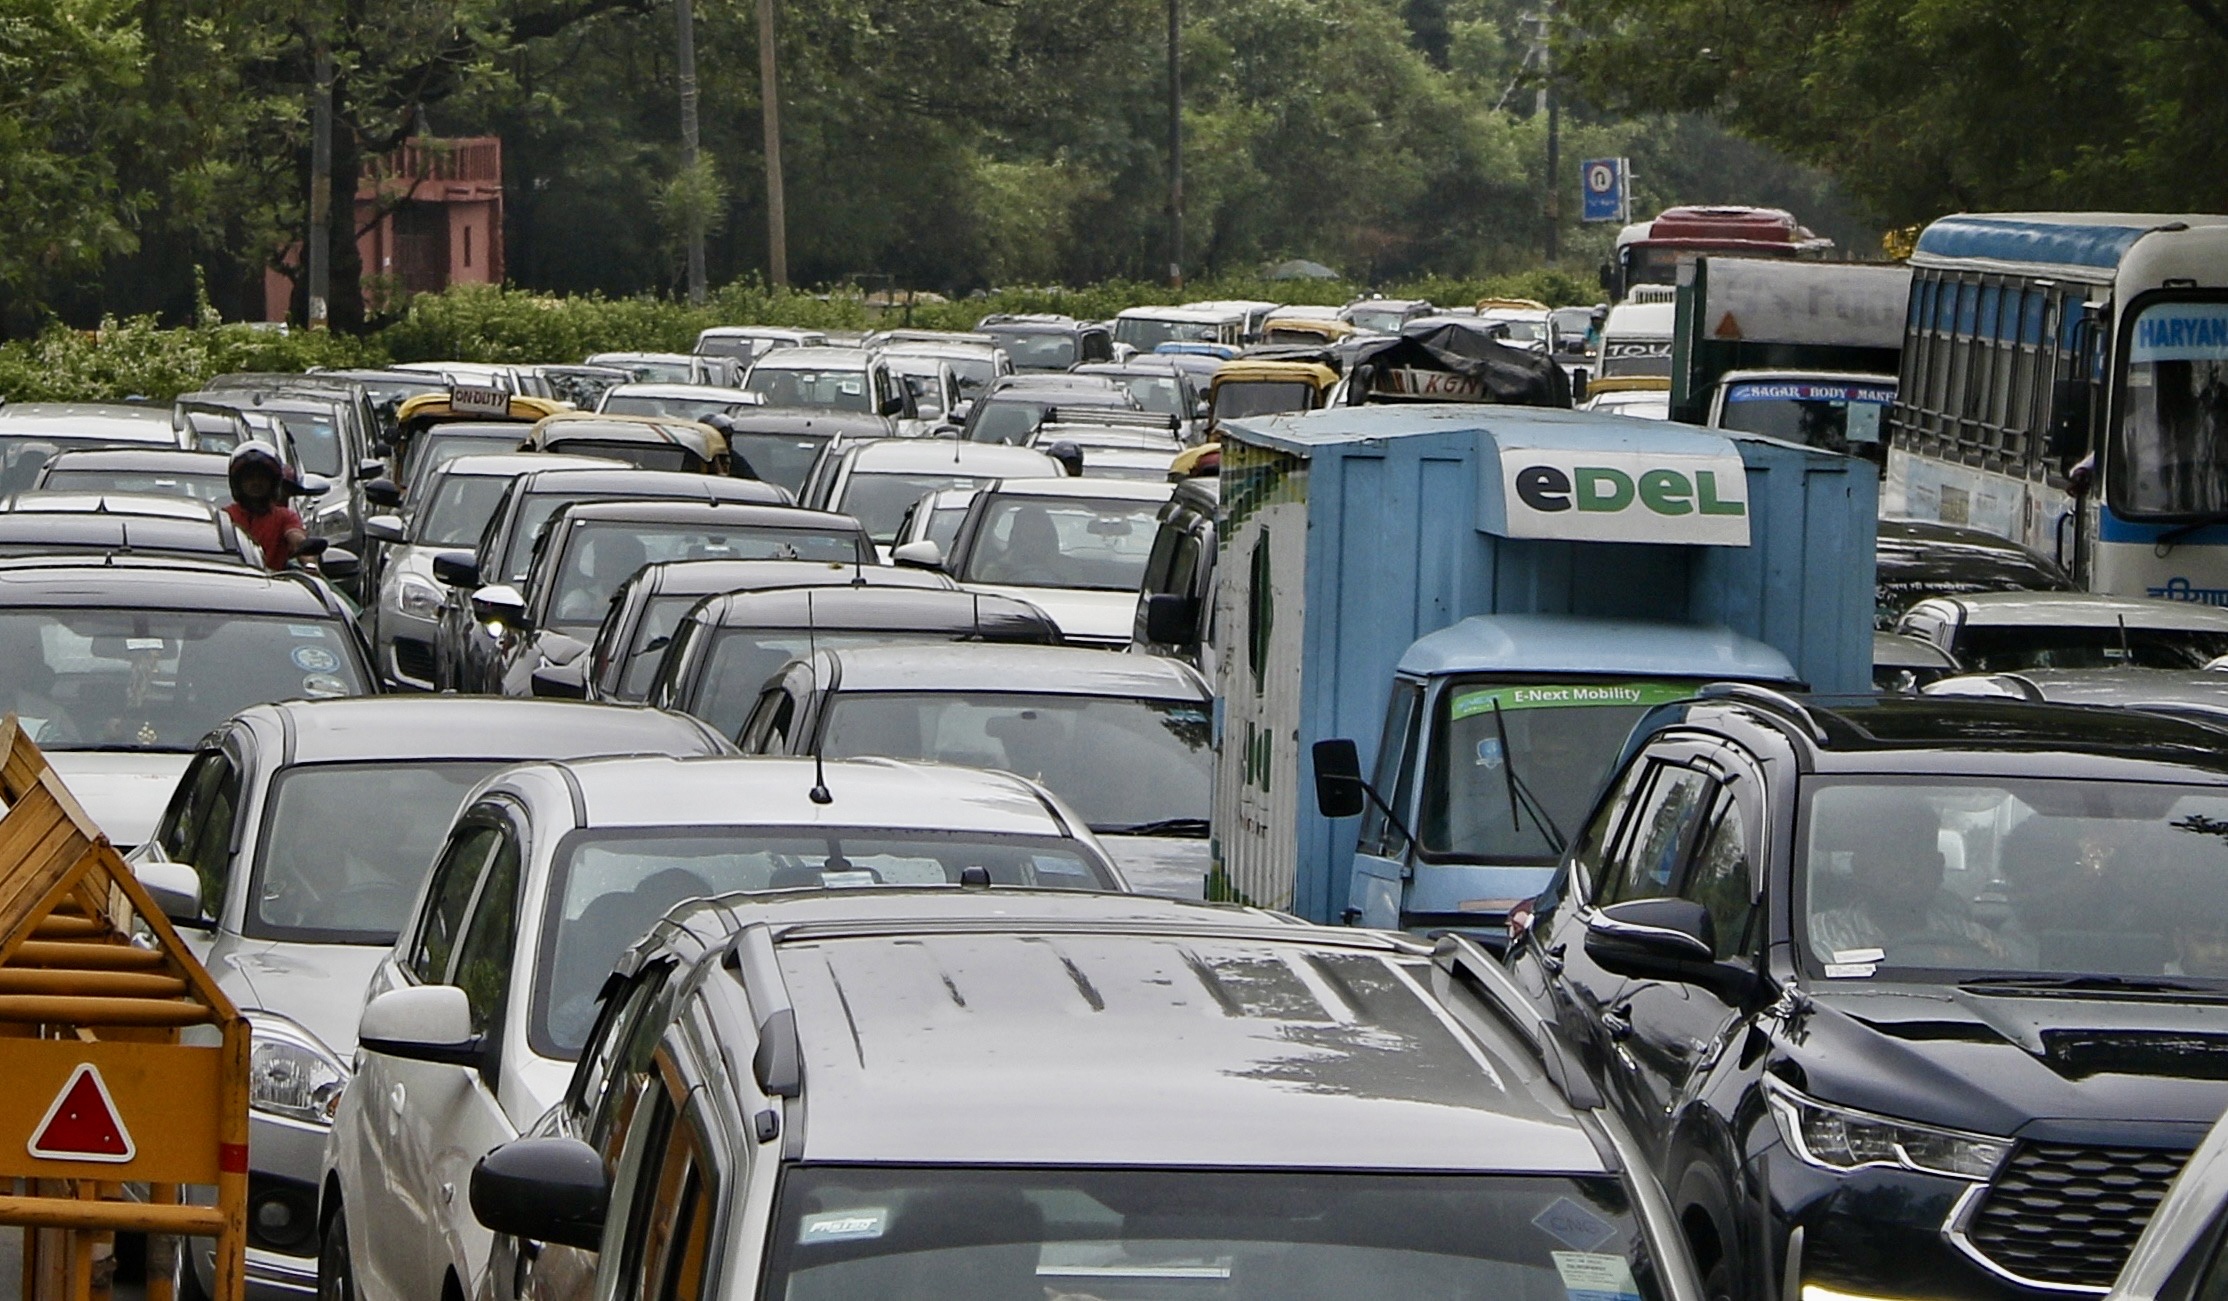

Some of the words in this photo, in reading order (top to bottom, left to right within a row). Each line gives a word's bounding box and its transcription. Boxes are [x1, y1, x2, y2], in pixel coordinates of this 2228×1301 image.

[1424, 374, 1479, 394] KGN
[1751, 386, 1799, 398] SAGAR
[1810, 387, 1847, 398] BODY
[1857, 389, 1897, 401] MAKE
[1514, 690, 1568, 703] E-Next
[1573, 687, 1641, 702] Mobility
